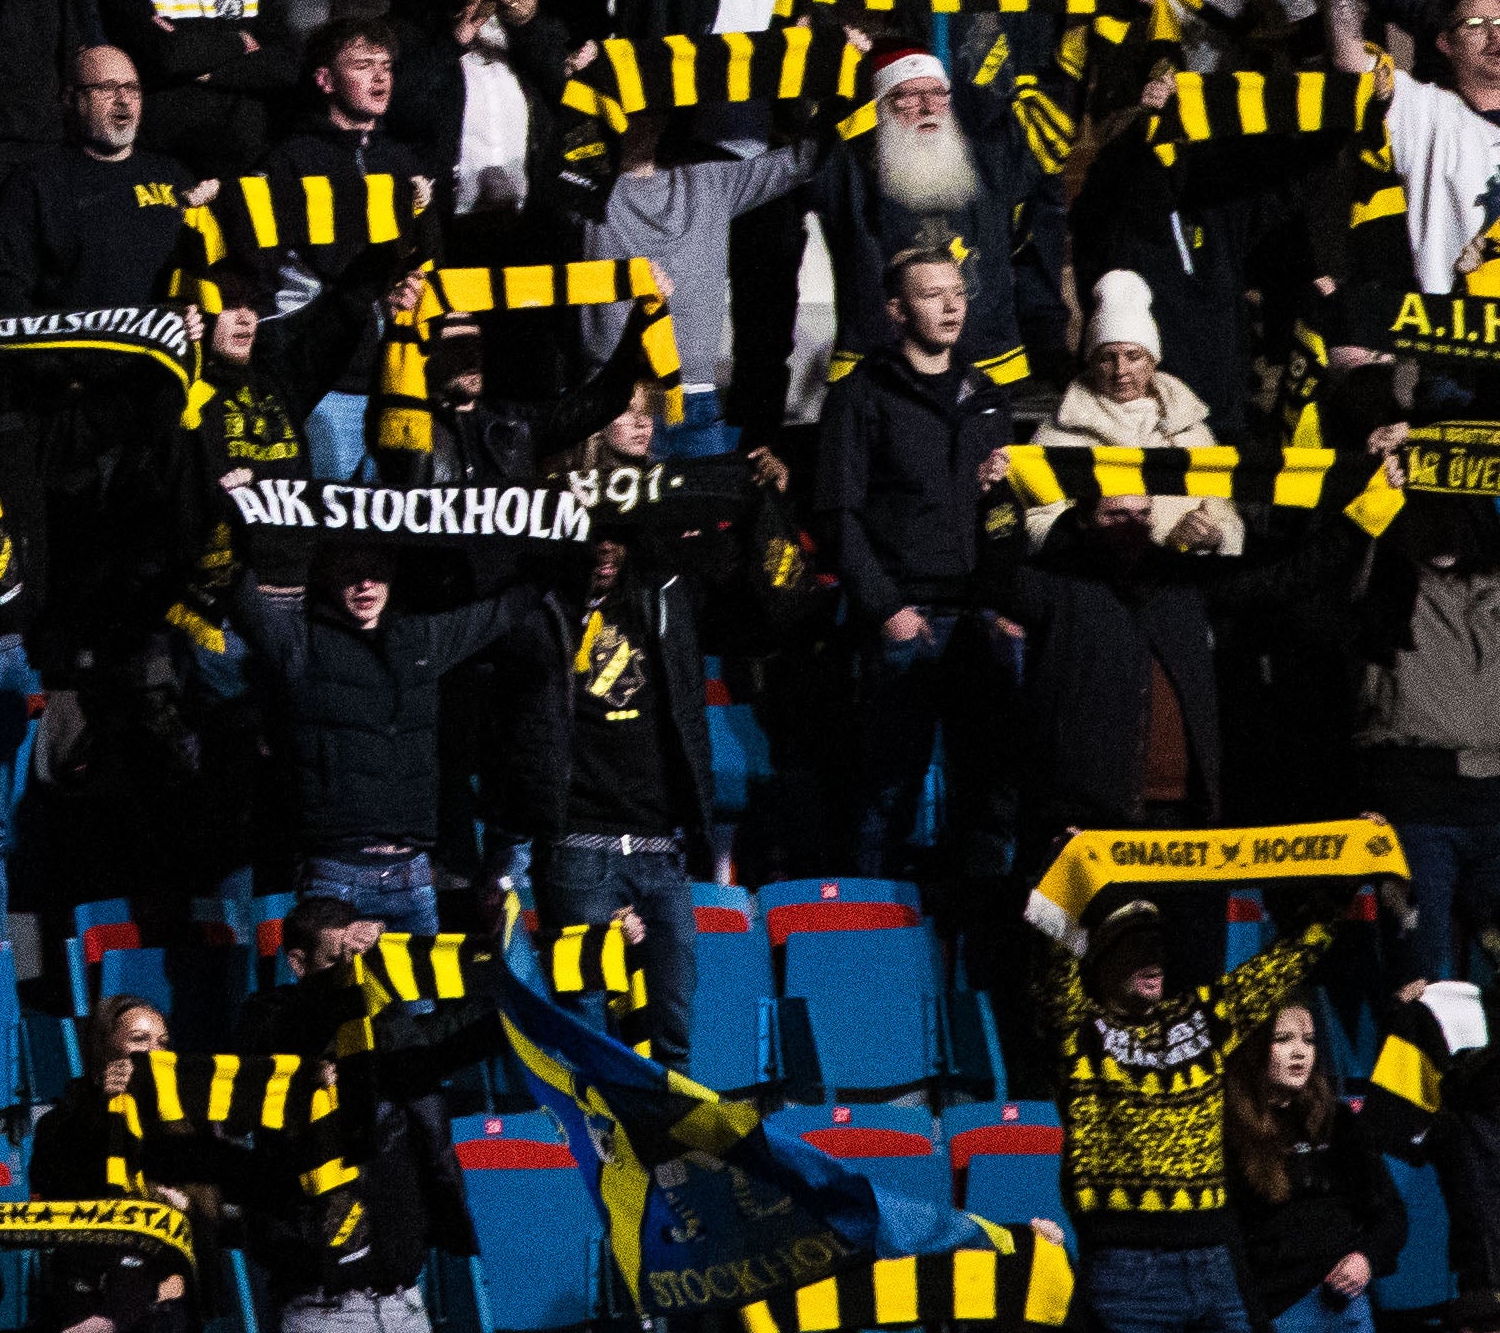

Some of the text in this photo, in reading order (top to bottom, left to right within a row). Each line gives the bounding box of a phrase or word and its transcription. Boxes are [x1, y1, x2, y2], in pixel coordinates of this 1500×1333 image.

[133, 183, 176, 209] AIK
[240, 481, 592, 542] AIK STOCKHOLM
[1110, 833, 1349, 869] GNAGET HOCKEY
